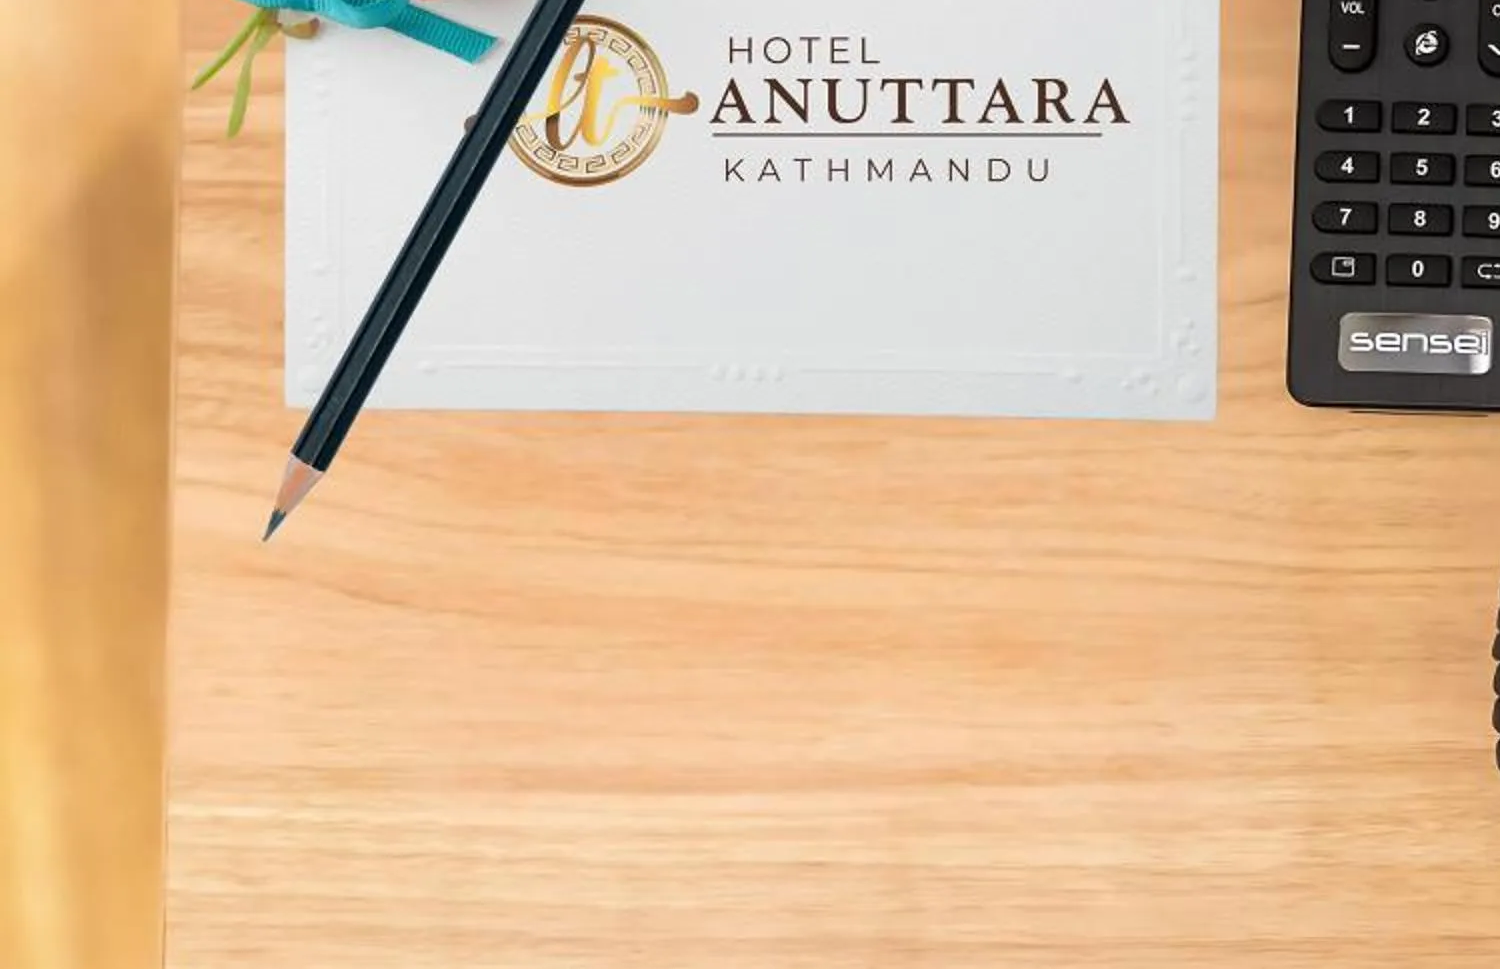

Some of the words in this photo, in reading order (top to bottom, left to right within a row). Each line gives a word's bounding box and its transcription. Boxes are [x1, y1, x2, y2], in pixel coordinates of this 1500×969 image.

[1340, 1, 1365, 15] VOL
[729, 36, 881, 65] HOTEL
[709, 77, 1131, 124] ANUTTARA
[1343, 106, 1354, 124] 1
[1417, 108, 1431, 126] 2
[725, 158, 1049, 183] KATHMANDU
[1340, 156, 1355, 174] 4
[1415, 158, 1429, 176] 5
[1339, 207, 1353, 225] 7
[1413, 210, 1427, 228] 8
[1487, 212, 1500, 230] 9
[1411, 260, 1425, 278] 0
[1349, 330, 1490, 356] sensei
